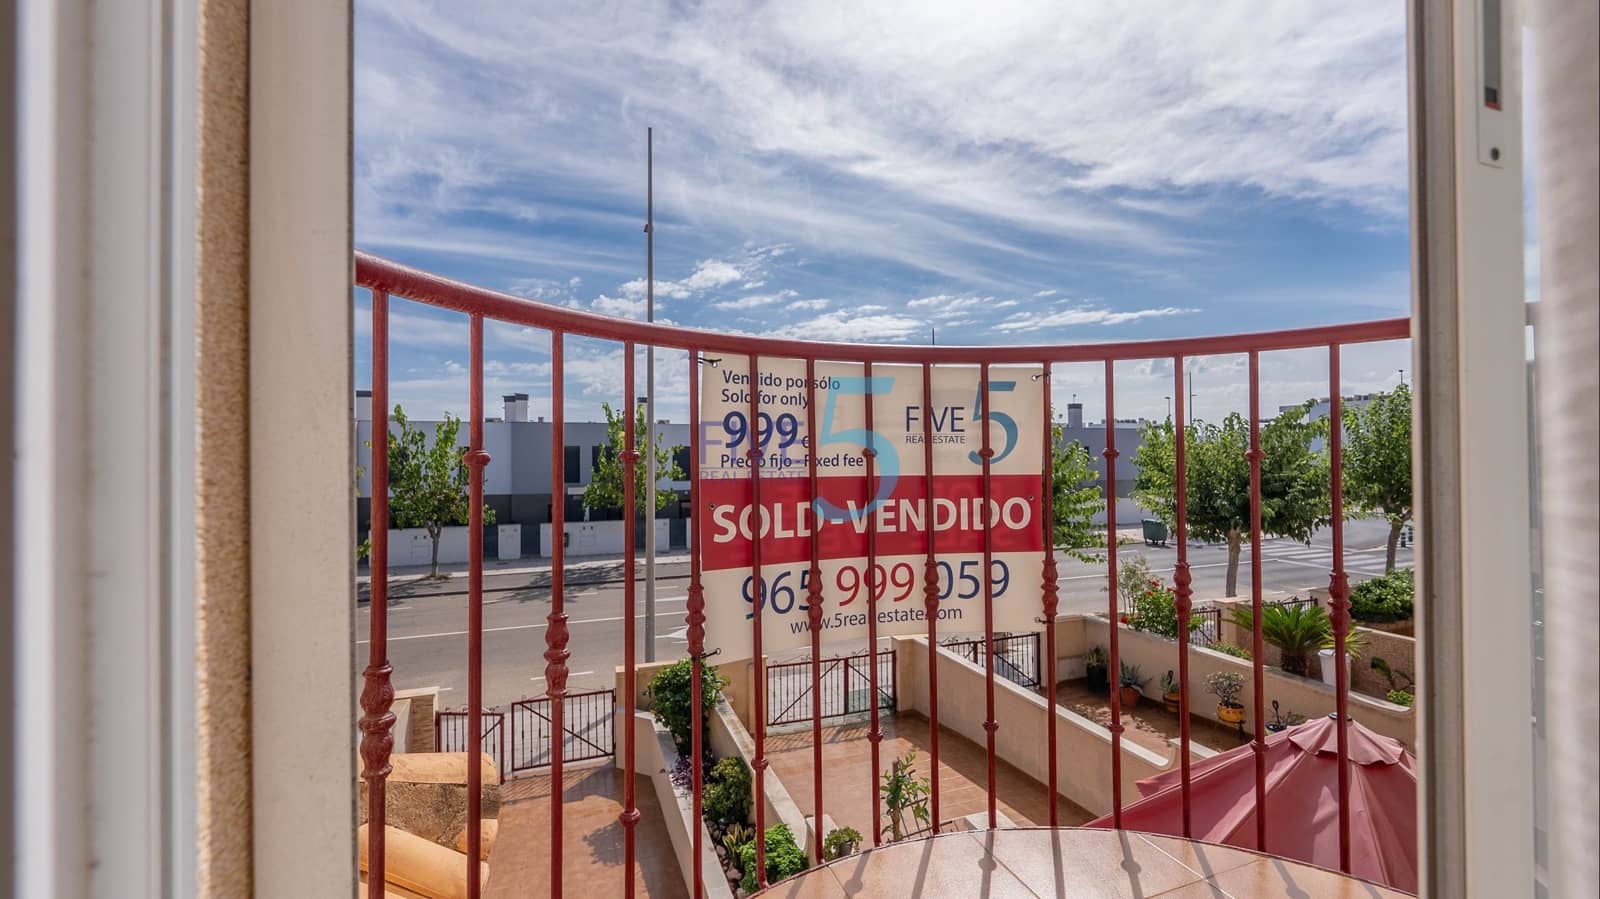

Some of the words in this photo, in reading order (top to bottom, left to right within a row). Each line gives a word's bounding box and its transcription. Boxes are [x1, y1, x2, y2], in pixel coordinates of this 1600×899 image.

[722, 369, 782, 387] Venido
[813, 376, 841, 390] sólo
[757, 391, 777, 405] for
[780, 392, 808, 409] only
[722, 411, 798, 449] 999
[905, 405, 965, 433] FVE
[968, 381, 1018, 466] 5
[905, 435, 927, 444] REA
[932, 435, 966, 444] ESTATE
[721, 454, 766, 469] Preco
[770, 454, 793, 470] fijo
[805, 454, 840, 467] Fxed
[844, 453, 864, 467] fee
[712, 497, 1032, 543] SOLD-VENDIDO
[836, 562, 915, 607] 999
